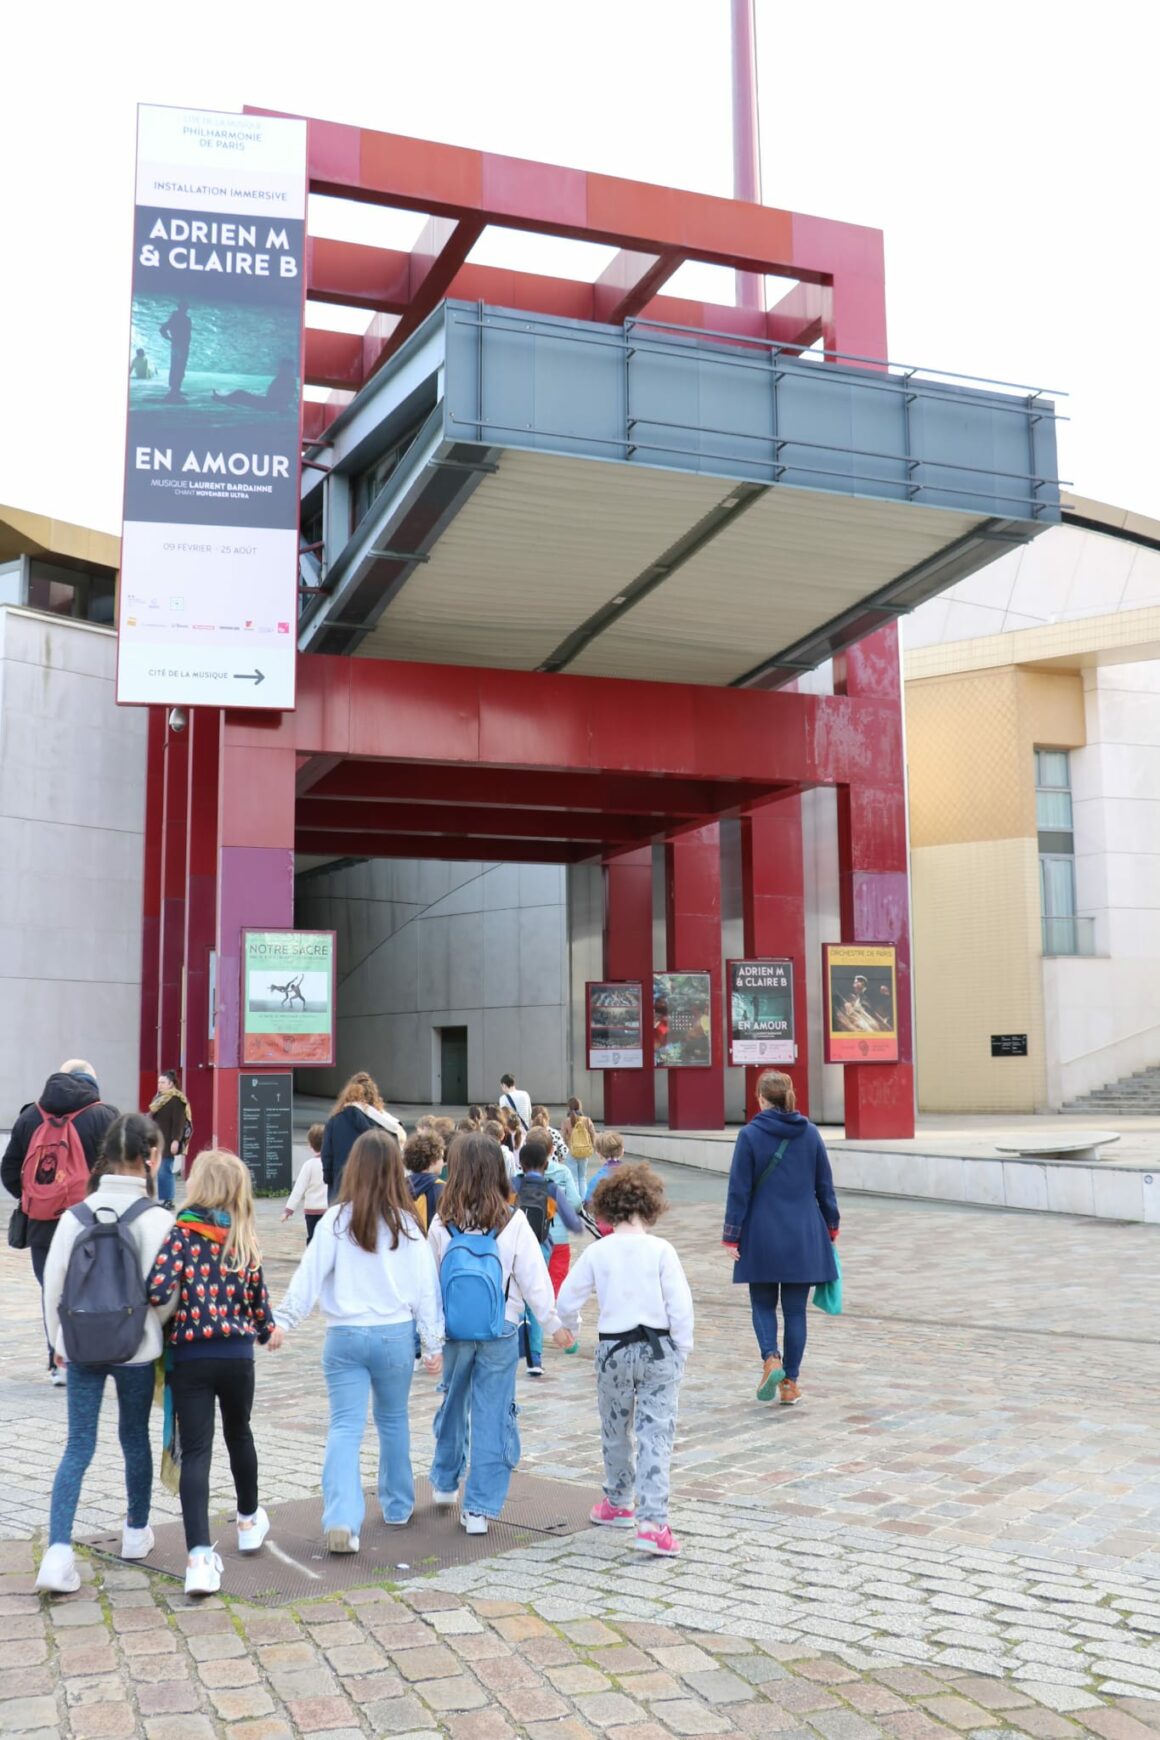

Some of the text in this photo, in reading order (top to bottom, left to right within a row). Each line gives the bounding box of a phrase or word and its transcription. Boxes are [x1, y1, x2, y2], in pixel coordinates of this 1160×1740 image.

[183, 126, 262, 142] PHILHARMONIE
[199, 138, 245, 151] DE PARIS
[154, 182, 288, 201] INSTALLATION IMMERSIVE
[149, 217, 290, 250] ADRIEN M
[139, 244, 298, 278] & CLAIRE B
[135, 446, 290, 478] EN AMOUR
[150, 479, 273, 493] MUSIQUE LAURENT BARDAINNE
[196, 490, 230, 498] NOVEMBER
[163, 543, 176, 552] 09
[177, 542, 212, 553] FÉVRIER
[220, 545, 232, 554] 25
[233, 543, 257, 555] AOÛT
[148, 668, 228, 681] CITÉ DE LA MUSIQUE
[249, 943, 329, 956] NOTRE SACRE
[866, 949, 875, 957] DE
[876, 949, 893, 957] PARIS
[738, 966, 785, 976] ADRIEN M
[735, 977, 788, 987] & CLAIRE B
[737, 1021, 788, 1031] EN AMOUR
